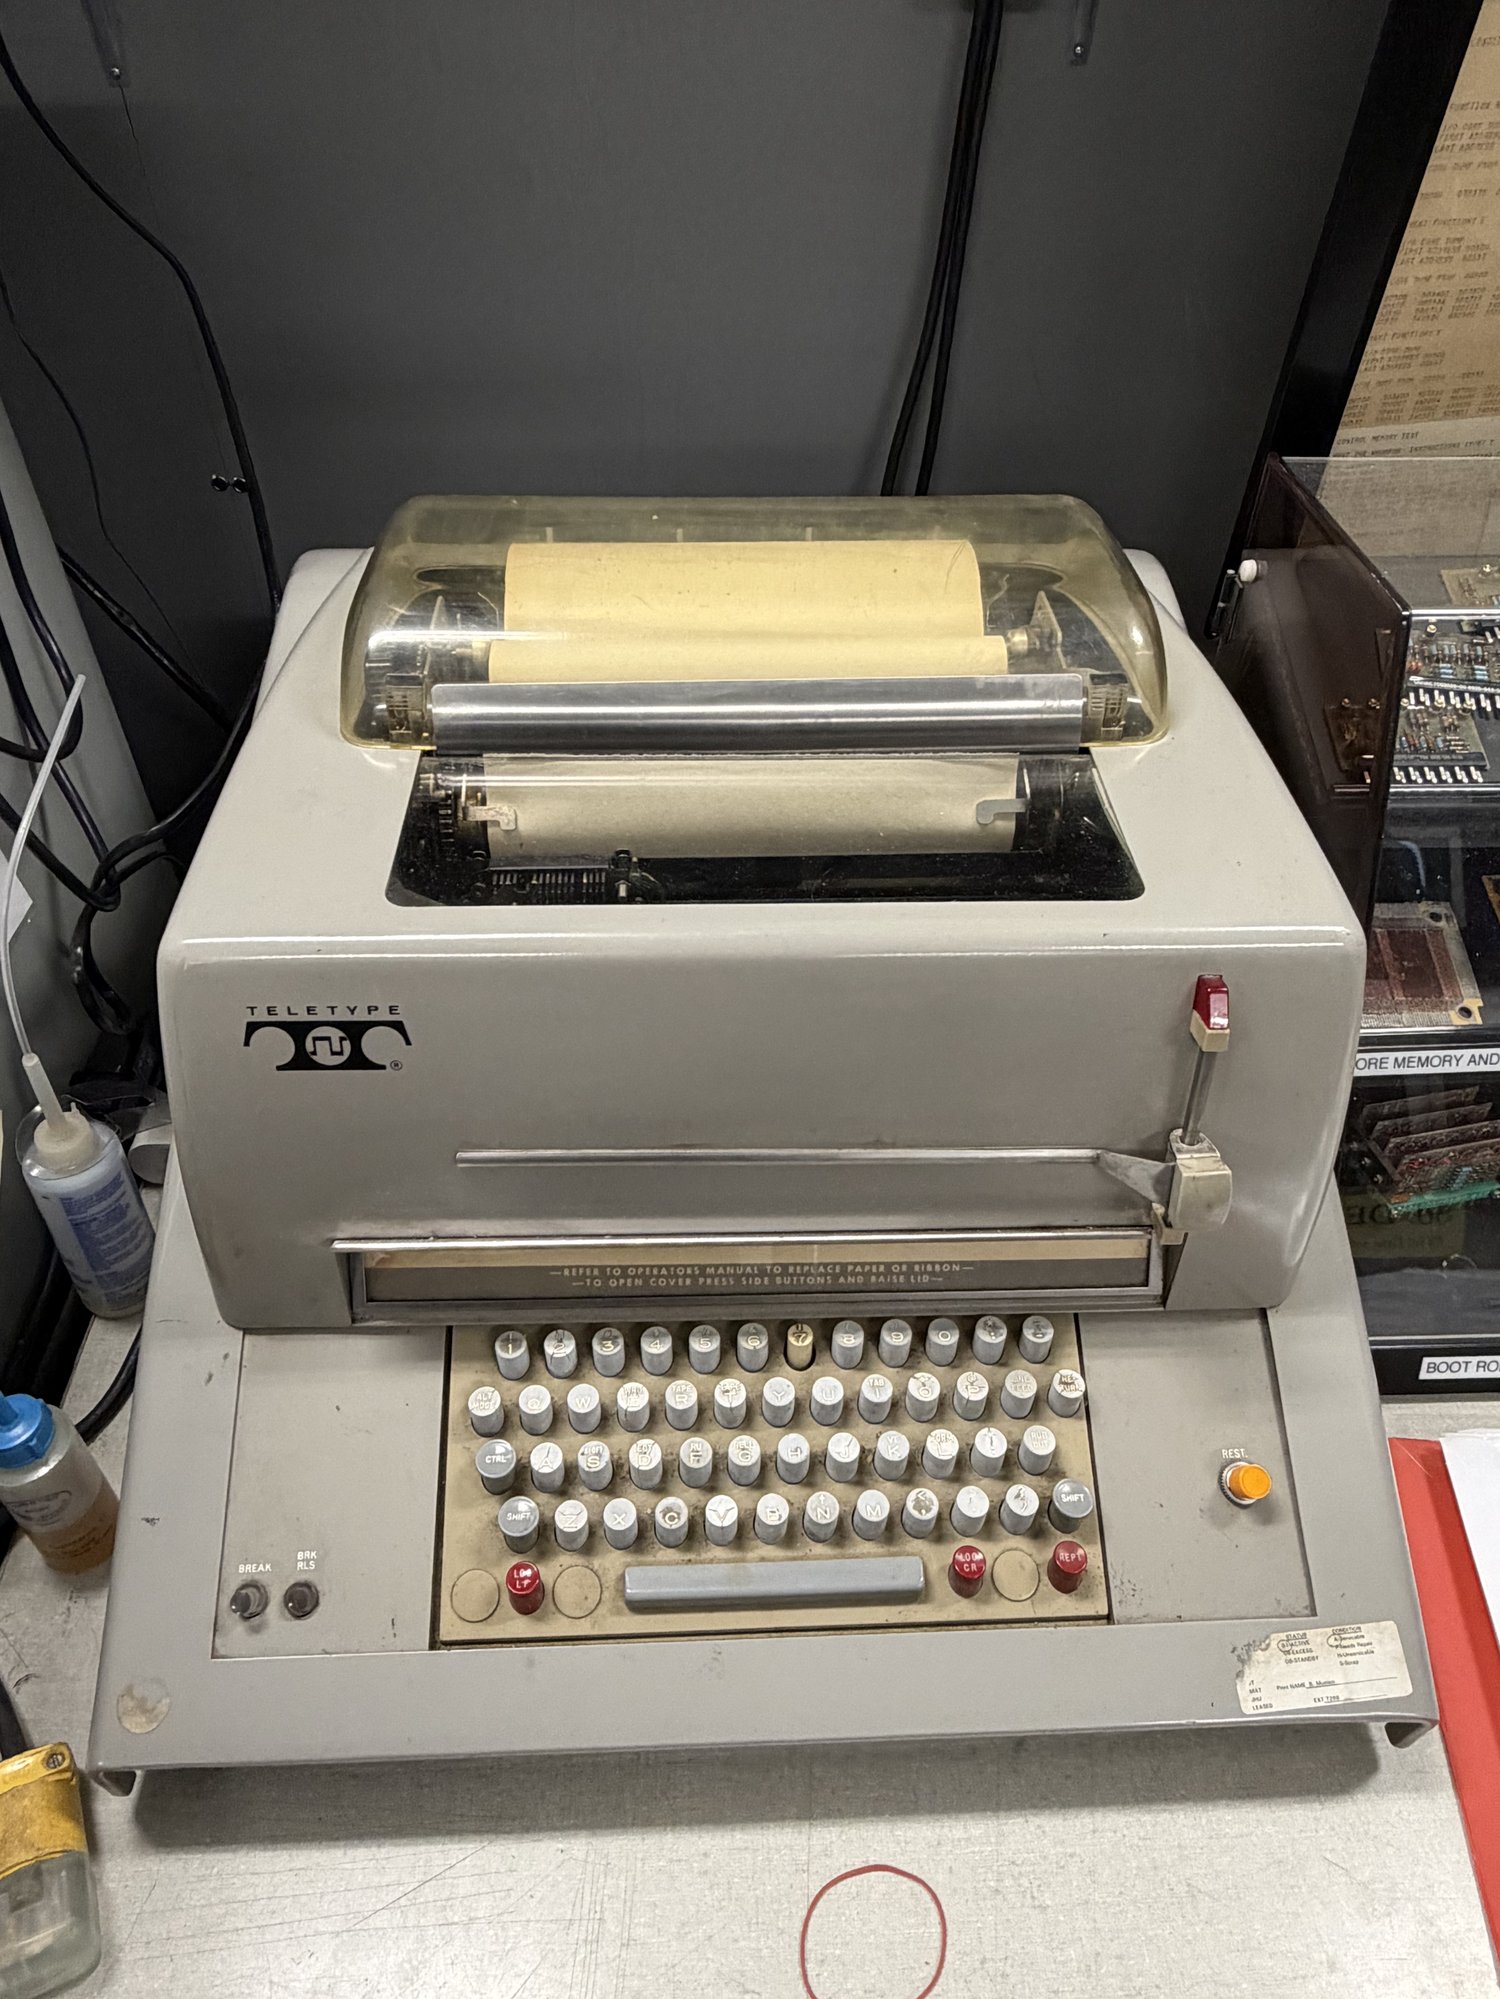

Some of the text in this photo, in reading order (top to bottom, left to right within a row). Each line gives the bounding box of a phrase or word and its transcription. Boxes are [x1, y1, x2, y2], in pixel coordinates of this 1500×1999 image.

[245, 1005, 401, 1017] TELETYPE
[1355, 1053, 1500, 1072] ORE MEMORY AND
[606, 1267, 622, 1276] TO
[628, 1266, 701, 1276] OPERATORS
[705, 1265, 759, 1275] MANUAL
[766, 1265, 782, 1275] TO
[788, 1264, 841, 1274] REPLACE
[847, 1264, 885, 1273] PAPER
[891, 1263, 908, 1272] OR
[608, 1278, 643, 1287] OPEN
[650, 1277, 692, 1286] COVER
[698, 1276, 735, 1286] PRESS
[741, 1276, 770, 1285] SIDE
[775, 1275, 833, 1285] BUTTONS
[838, 1275, 864, 1284] AND
[870, 1274, 905, 1283] RAISE
[747, 1335, 760, 1346] 6
[794, 1331, 807, 1344] 7
[842, 1334, 856, 1344] 8
[890, 1331, 904, 1342] 9
[601, 1340, 615, 1352] 3
[649, 1339, 661, 1350] 4
[699, 1337, 711, 1349] 5
[1425, 1360, 1500, 1374] BOOT RO
[671, 1383, 693, 1393] TAPE
[868, 1378, 885, 1387] TAB
[675, 1393, 688, 1404] R
[772, 1391, 788, 1402] Y
[822, 1389, 835, 1401] U
[527, 1398, 541, 1410] Q
[575, 1396, 591, 1409] W
[690, 1442, 702, 1451] RU
[887, 1445, 900, 1457] K
[690, 1452, 702, 1464] F
[738, 1451, 752, 1462] G
[788, 1448, 801, 1459] H
[835, 1446, 849, 1459] J
[485, 1455, 507, 1464] CTRL
[586, 1455, 600, 1468] S
[638, 1455, 652, 1467] D
[1060, 1493, 1085, 1503] SHIFT
[816, 1506, 831, 1520] N
[865, 1504, 882, 1517] M
[506, 1512, 531, 1521] SHIFT
[612, 1512, 626, 1526] X
[664, 1511, 679, 1525] C
[296, 1550, 318, 1560] BRK
[1058, 1552, 1082, 1563] REPT
[238, 1563, 272, 1573] BREAK
[296, 1560, 316, 1571] RLS
[963, 1562, 978, 1573] CR
[1251, 1702, 1274, 1711] LEASED
